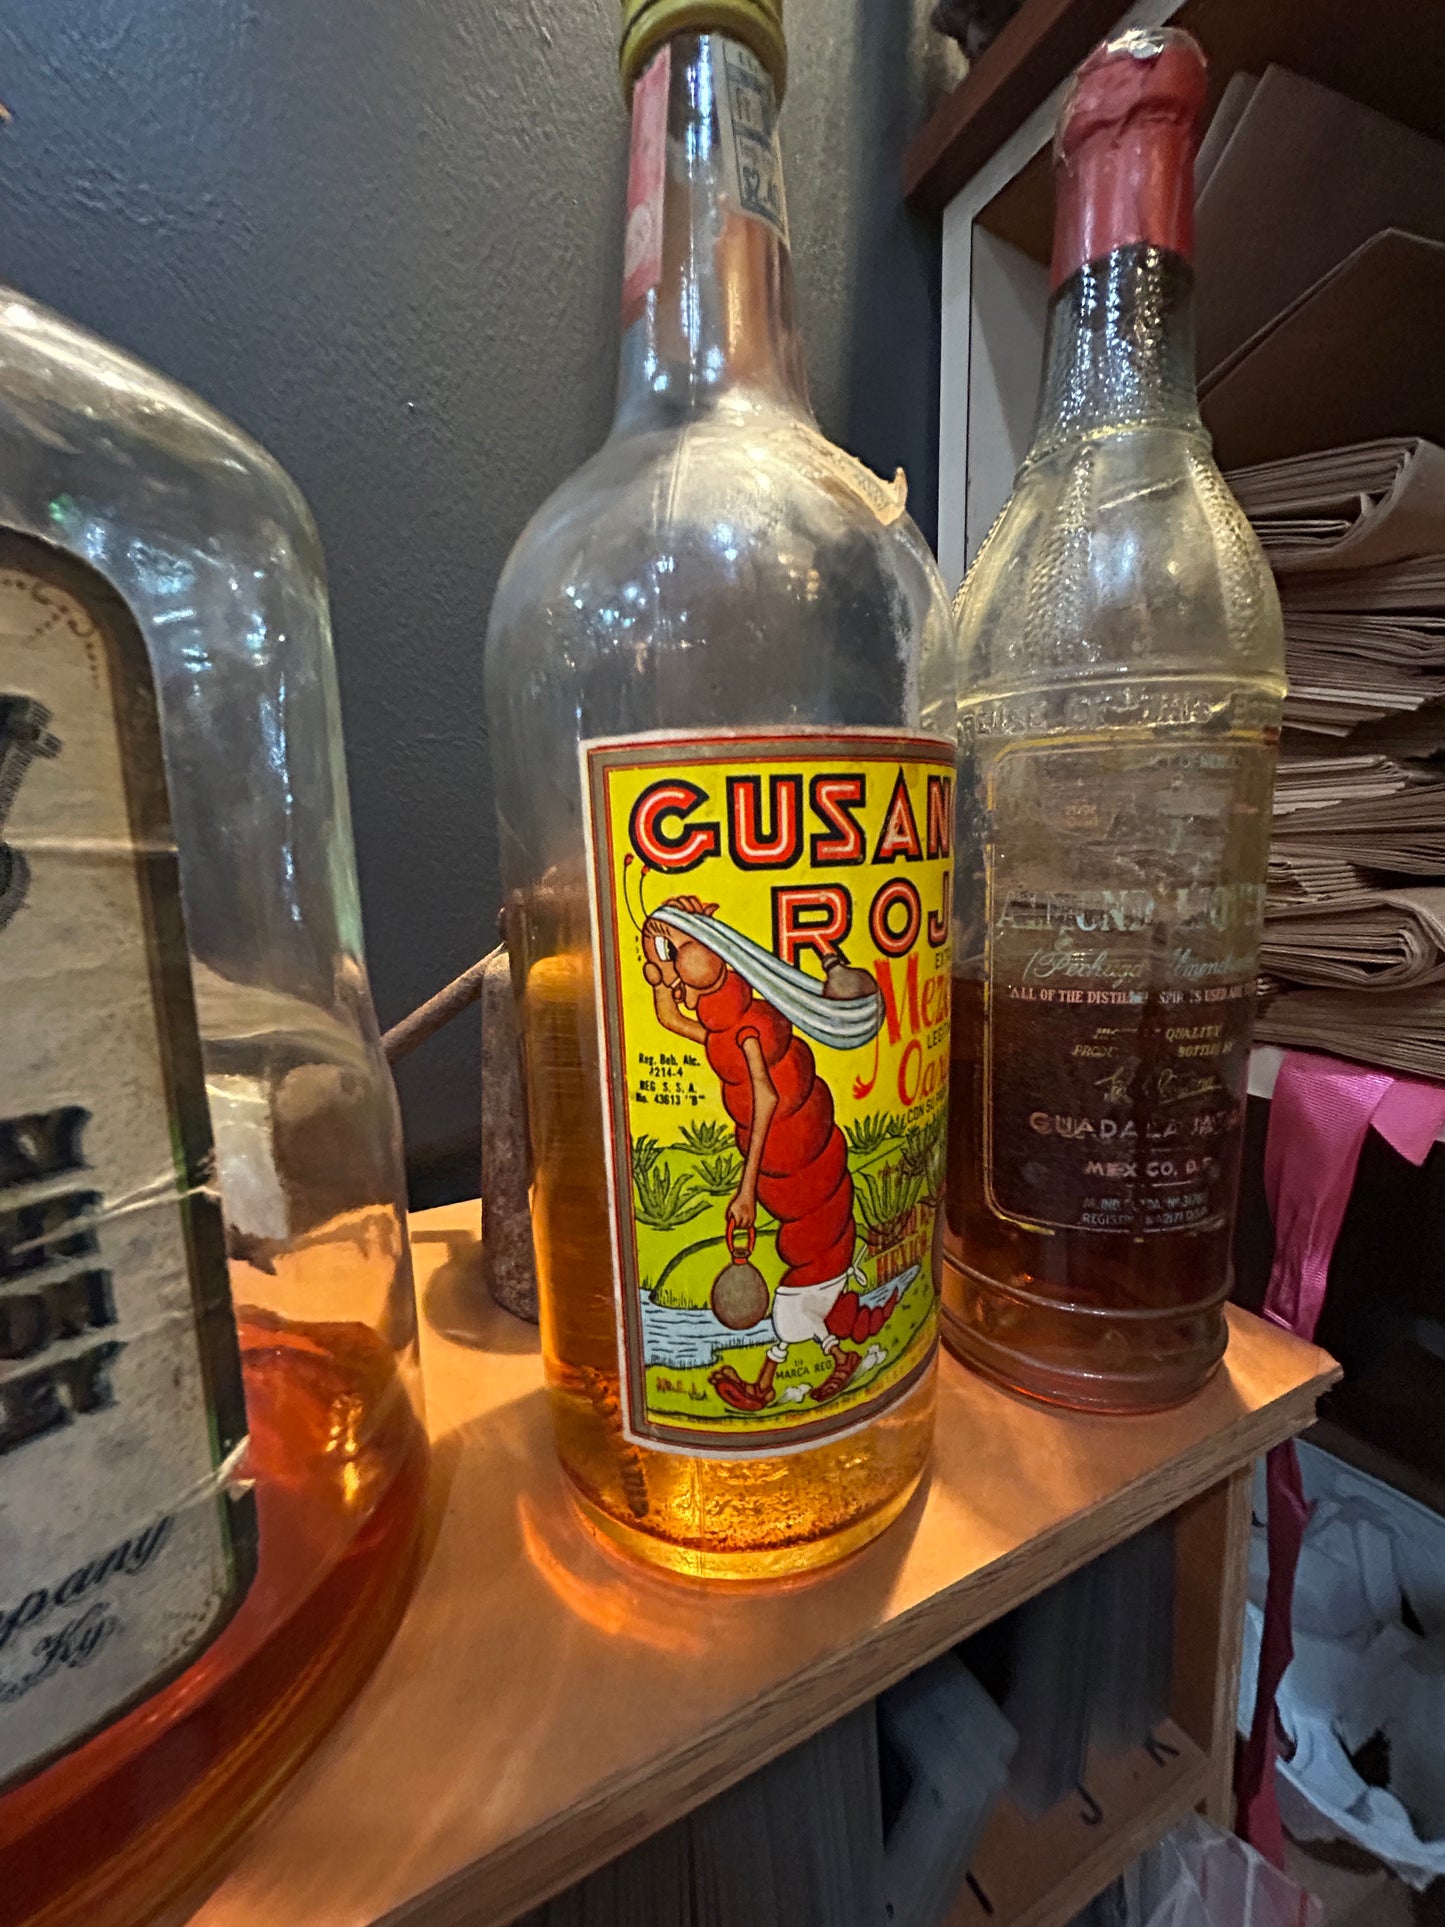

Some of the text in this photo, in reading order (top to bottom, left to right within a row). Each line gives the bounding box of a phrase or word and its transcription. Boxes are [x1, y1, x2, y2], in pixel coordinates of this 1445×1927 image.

[1010, 987, 1036, 1000] ALL
[1040, 988, 1056, 1001] OF
[1058, 989, 1083, 1003] THE
[776, 1366, 811, 1380] MARCA
